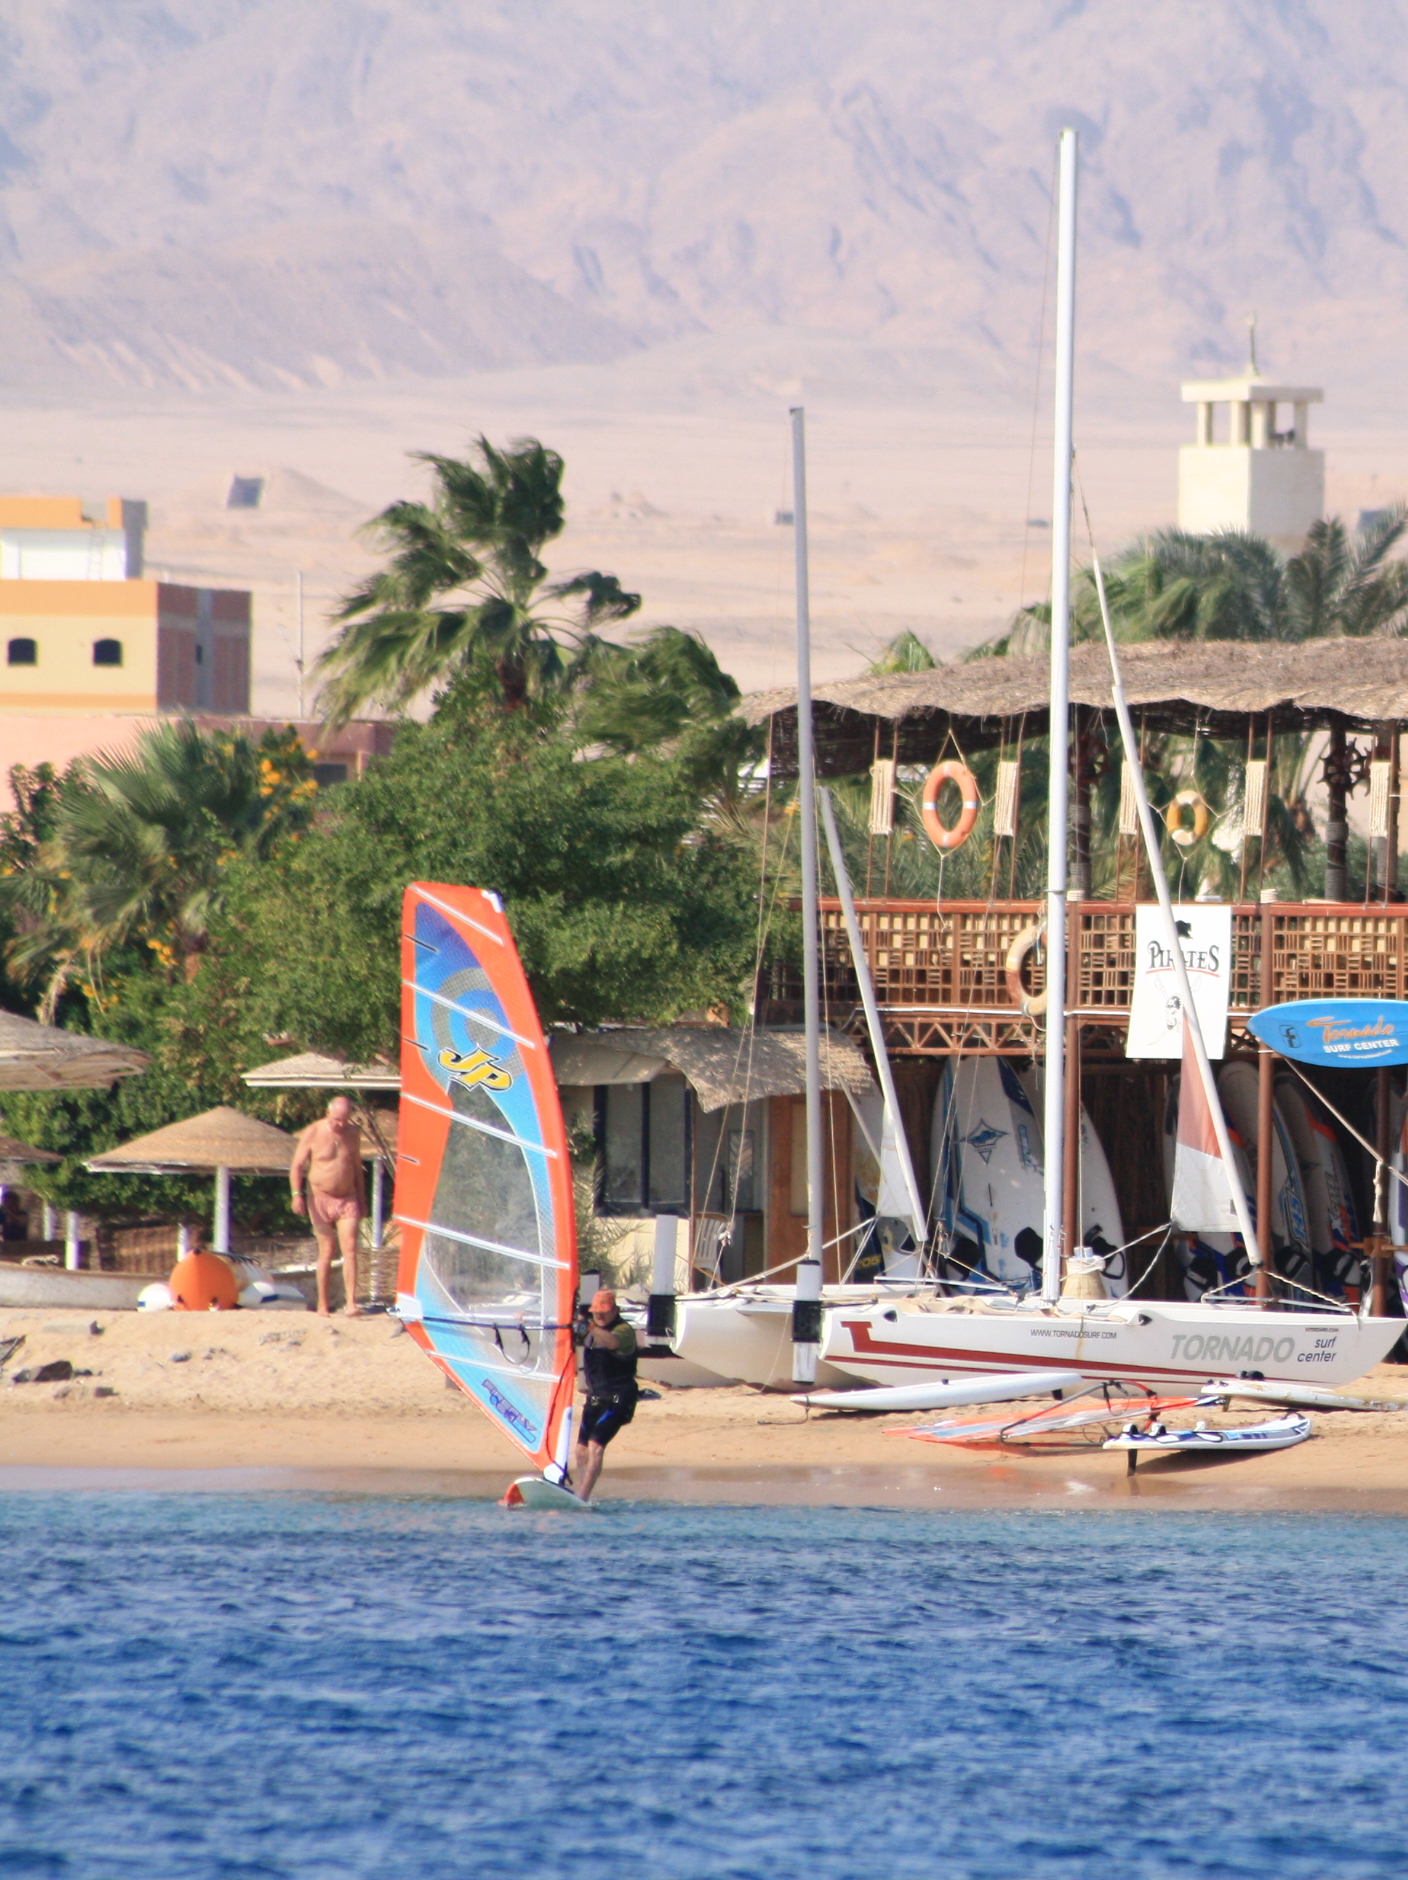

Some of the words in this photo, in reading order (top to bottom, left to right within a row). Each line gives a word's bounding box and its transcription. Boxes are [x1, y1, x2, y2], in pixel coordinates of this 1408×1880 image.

[1307, 1016, 1395, 1043] Tornado
[1323, 1042, 1351, 1054] SURF
[1353, 1038, 1399, 1051] CENTER
[1170, 1334, 1296, 1363] TORNADO
[1314, 1336, 1337, 1348] surf
[1297, 1351, 1336, 1363] center
